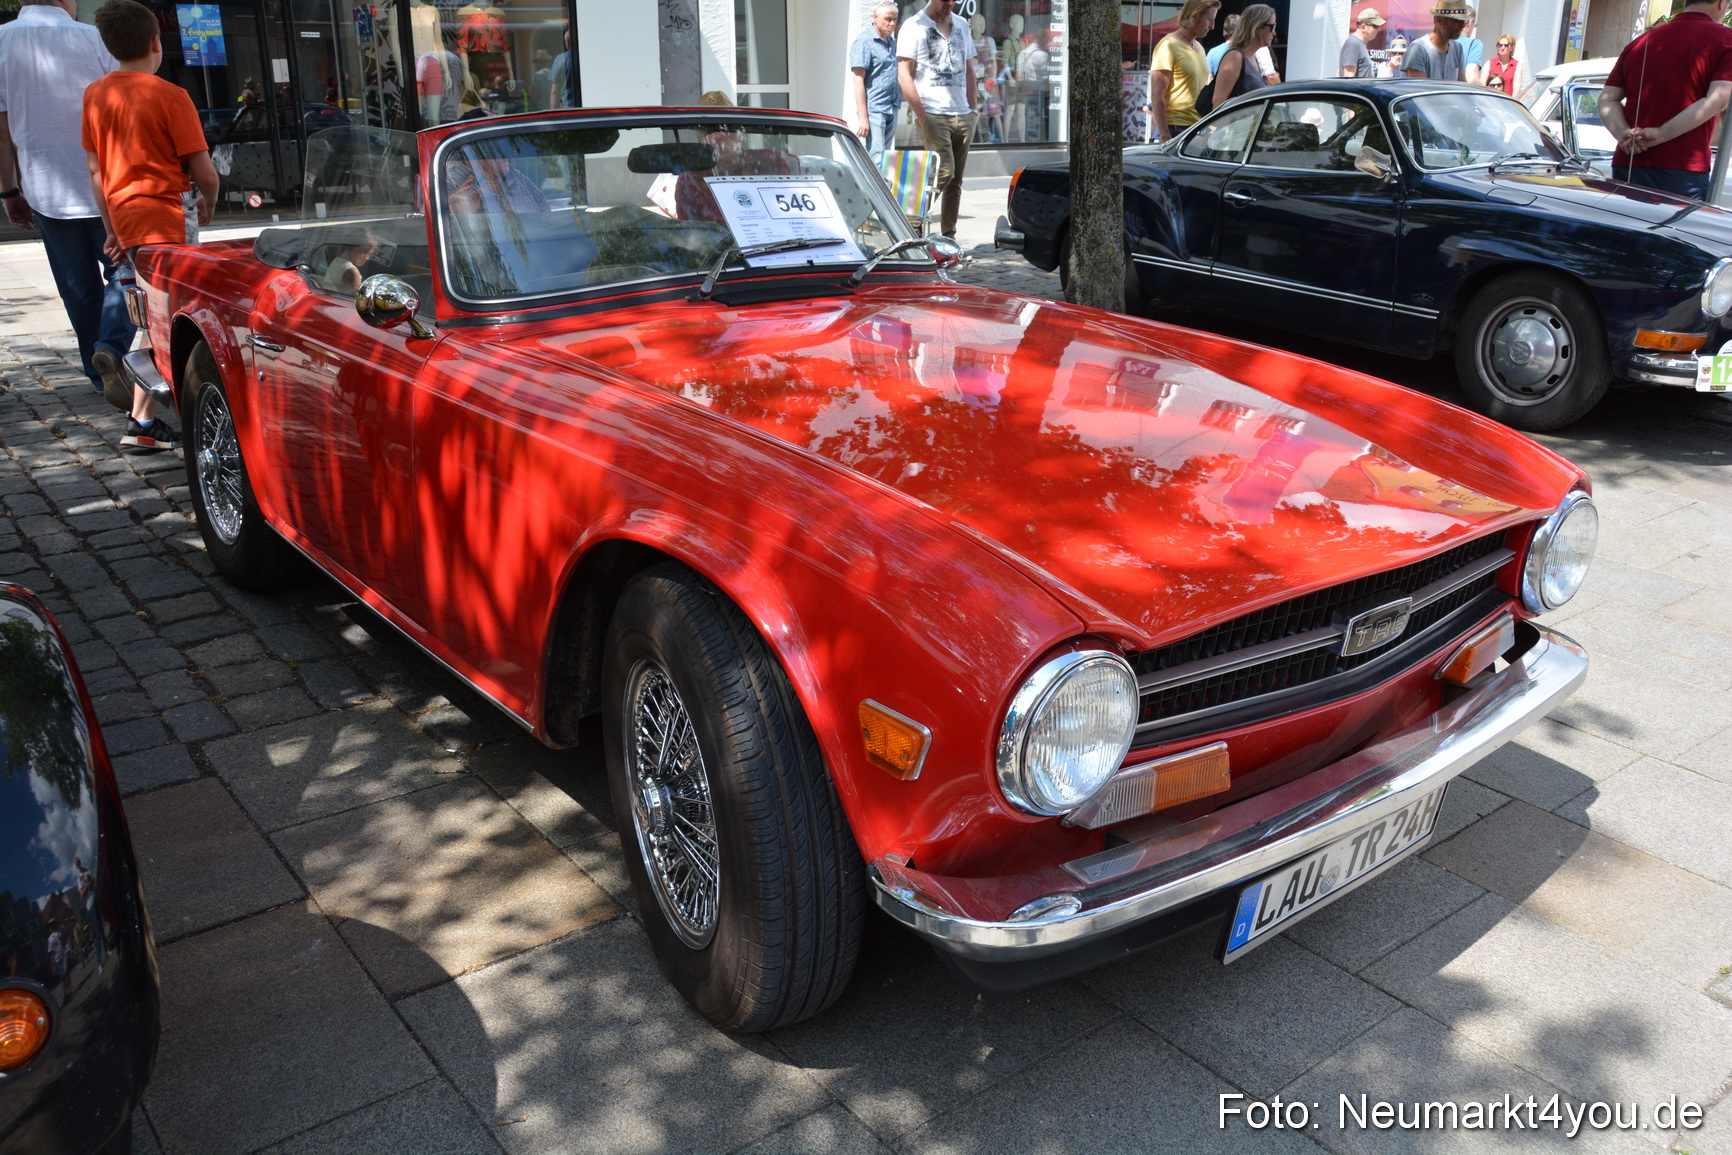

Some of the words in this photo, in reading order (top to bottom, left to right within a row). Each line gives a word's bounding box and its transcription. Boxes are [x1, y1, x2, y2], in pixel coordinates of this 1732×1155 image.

[775, 193, 817, 213] 546
[1355, 609, 1409, 647] TR6
[1235, 922, 1246, 938] D
[1254, 853, 1329, 932] LAU
[1345, 820, 1387, 879] TR
[1382, 786, 1444, 858] 24H
